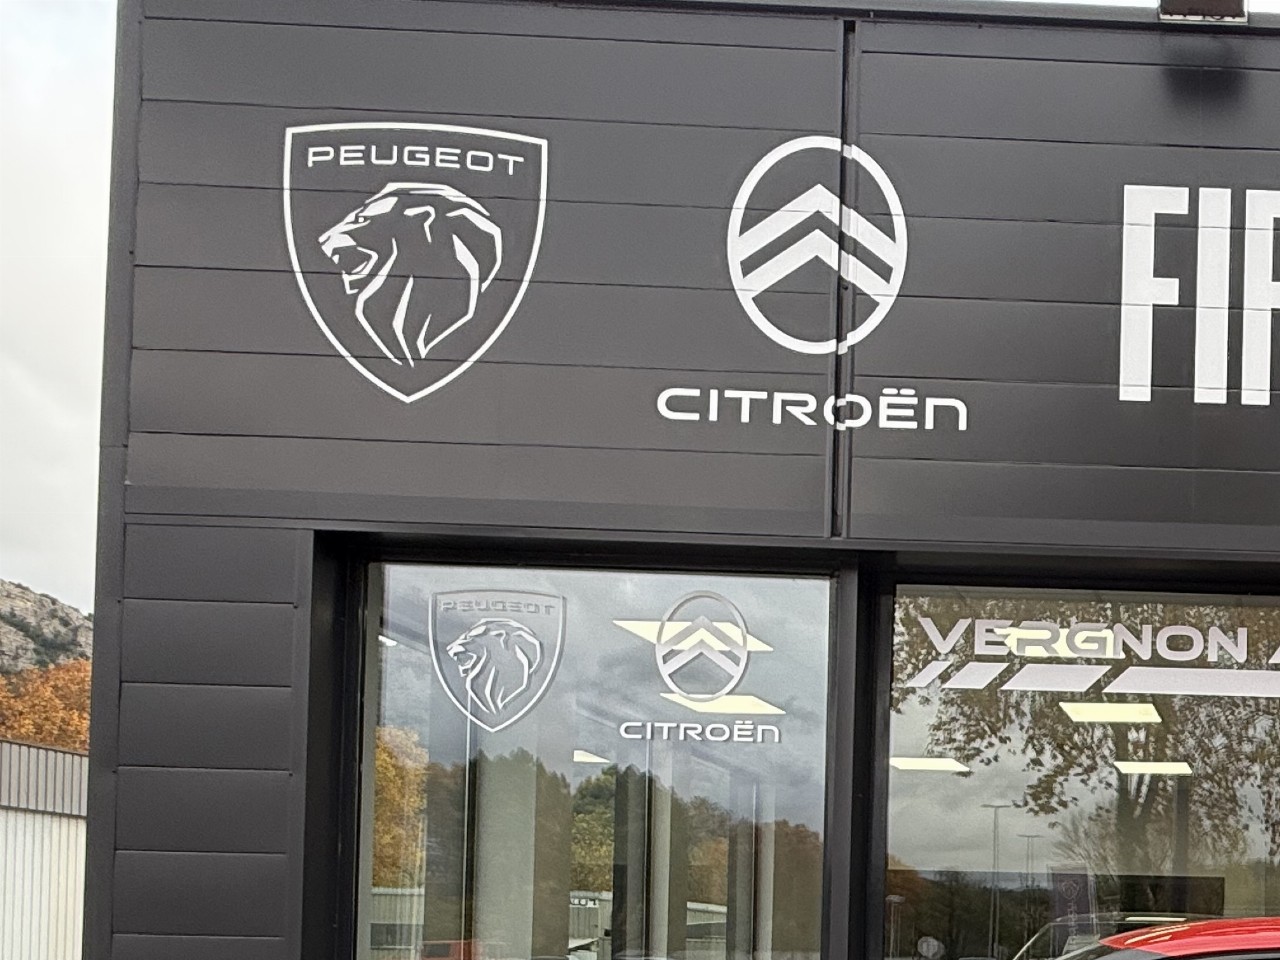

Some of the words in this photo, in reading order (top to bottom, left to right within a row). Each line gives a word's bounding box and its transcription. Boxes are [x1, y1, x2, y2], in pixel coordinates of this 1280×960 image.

[307, 144, 525, 176] PEUGEOT
[656, 387, 969, 432] CITROËN
[440, 599, 556, 616] PEUGEOT
[918, 616, 1249, 664] VERGNON
[618, 719, 783, 744] CITROËN
